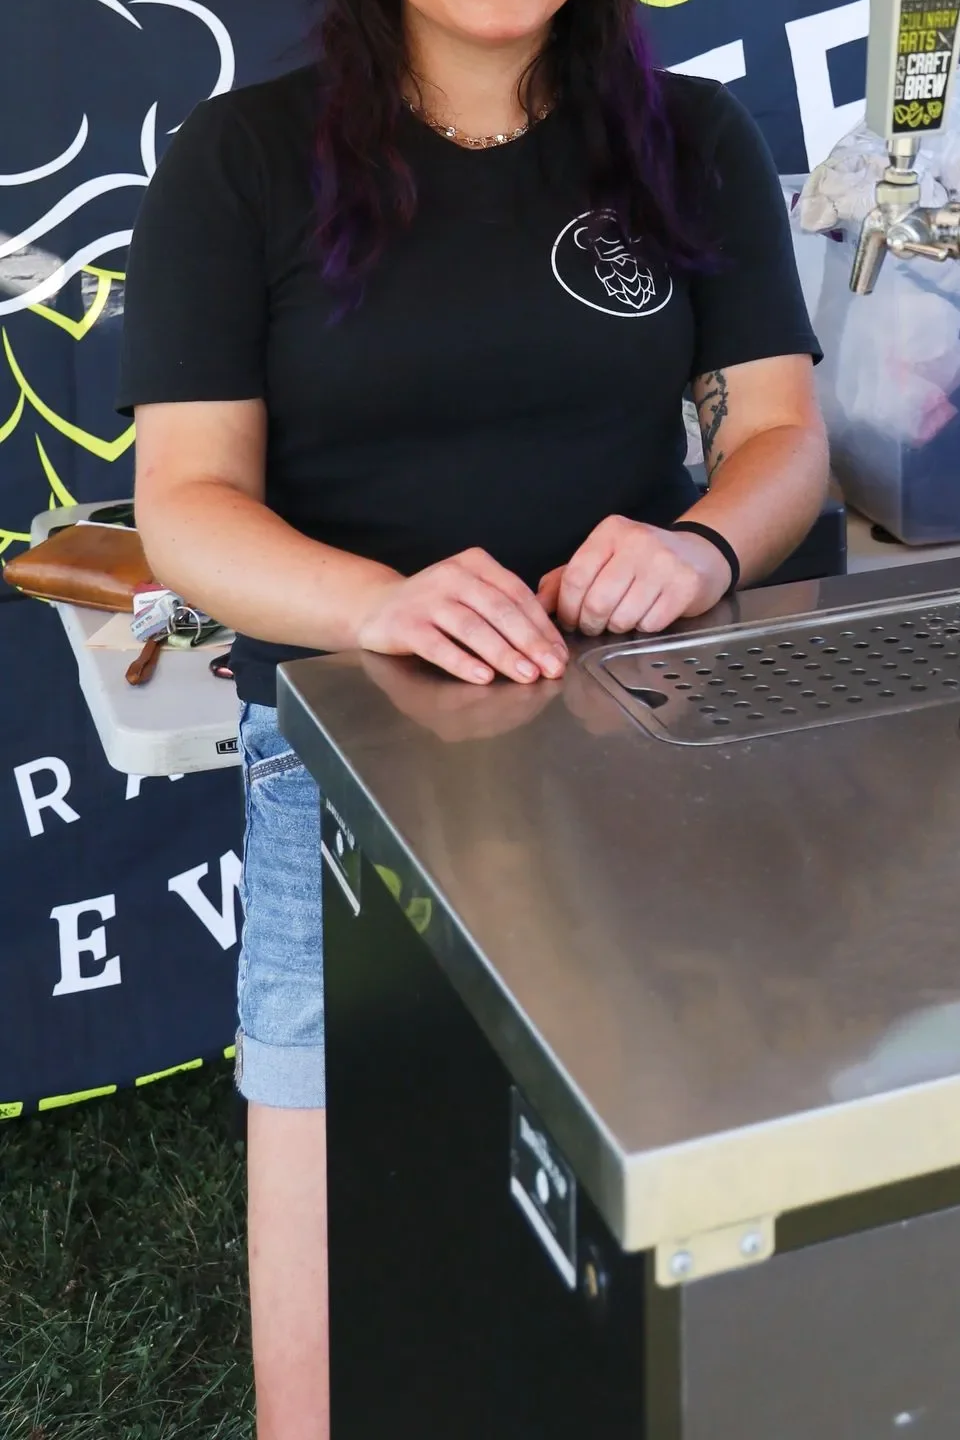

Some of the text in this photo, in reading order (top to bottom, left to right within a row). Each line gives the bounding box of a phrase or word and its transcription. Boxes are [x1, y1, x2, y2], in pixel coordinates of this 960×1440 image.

[898, 30, 937, 53] ARTS
[906, 51, 952, 76] CRAFT
[903, 73, 947, 101] BREW
